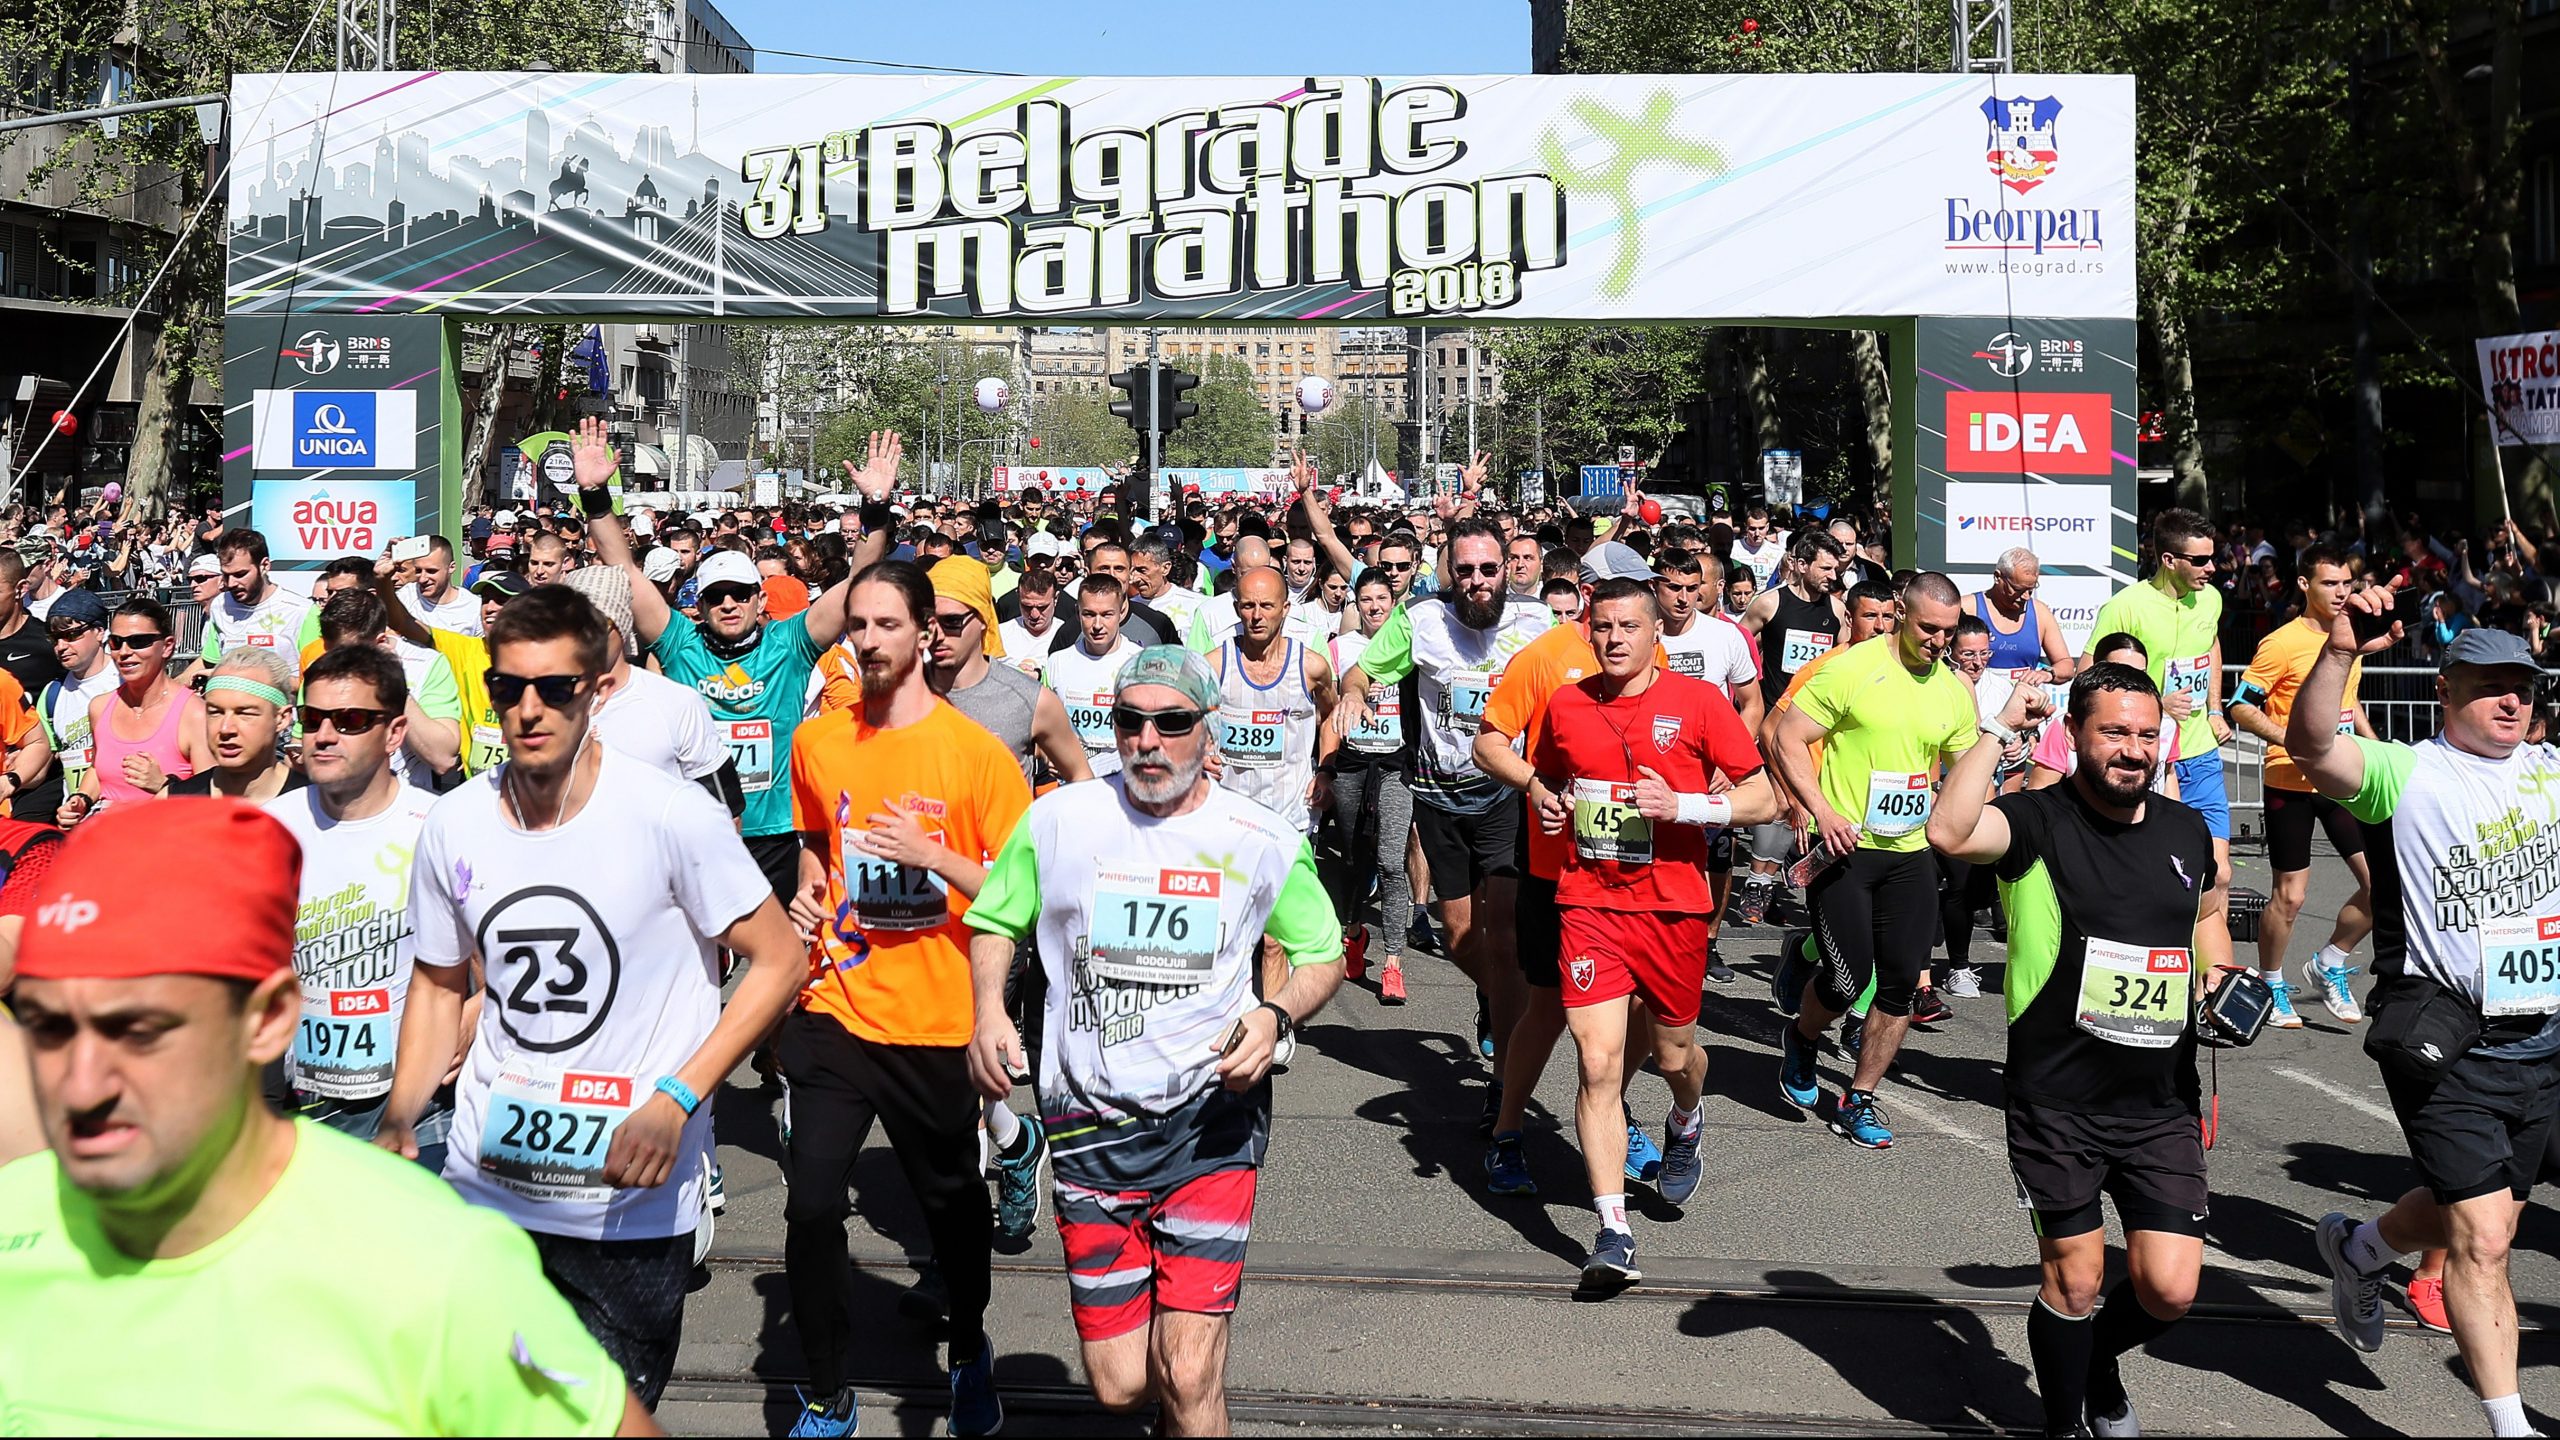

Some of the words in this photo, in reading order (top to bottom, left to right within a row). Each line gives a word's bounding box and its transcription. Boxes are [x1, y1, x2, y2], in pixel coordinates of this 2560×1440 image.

[858, 75, 1468, 232] Belgrade
[1945, 198, 2103, 255] Београд
[878, 172, 1568, 317] marathon
[1945, 259, 2104, 276] www.beograd.rs
[1388, 262, 1525, 319] 2018
[2526, 386, 2560, 410] TAT
[1969, 412, 2088, 454] iDEA
[299, 438, 368, 455] UNIQA
[1018, 471, 1040, 481] aqu
[1209, 472, 1236, 488] 5km
[293, 501, 377, 525] aqua
[1978, 516, 2095, 532] INTERSPORT
[298, 527, 373, 550] viva
[2050, 606, 2095, 621] rans
[2073, 622, 2093, 630] DAN
[251, 637, 270, 645] iDEA
[1669, 657, 1703, 666] RKOUT
[697, 679, 765, 701] adidas
[2173, 671, 2208, 692] 3266
[1071, 709, 1114, 730] 4994
[736, 725, 764, 737] iDEA
[1226, 726, 1275, 747] 2389
[484, 745, 509, 766] 75
[724, 743, 757, 767] 71
[909, 797, 945, 815] Sava
[1877, 793, 1925, 816] 4058
[1593, 806, 1623, 832] 45
[2449, 845, 2477, 869] 31.
[857, 861, 931, 896] 1112
[1104, 872, 1154, 885] INTERSPORT
[1168, 874, 1210, 893] iDEA
[37, 892, 100, 933] vip
[1123, 900, 1189, 941] 176
[2490, 927, 2534, 936] INTERSPORT
[1135, 954, 1188, 969] RODOLJUB
[2096, 950, 2145, 963] INTERSPORT
[2154, 954, 2183, 969] iDEA
[2498, 947, 2560, 985] 405
[497, 928, 588, 1014] 23
[337, 994, 381, 1012] iDEA
[2109, 975, 2168, 1012] 324
[301, 1017, 376, 1059] 1974
[1103, 1015, 1144, 1048] 2018
[2133, 1023, 2154, 1034] SAŠA
[505, 1072, 557, 1091] INTERSPORT
[571, 1080, 621, 1101] iDEA
[500, 1104, 609, 1157] 2827
[531, 1171, 586, 1186] VLADIMIR
